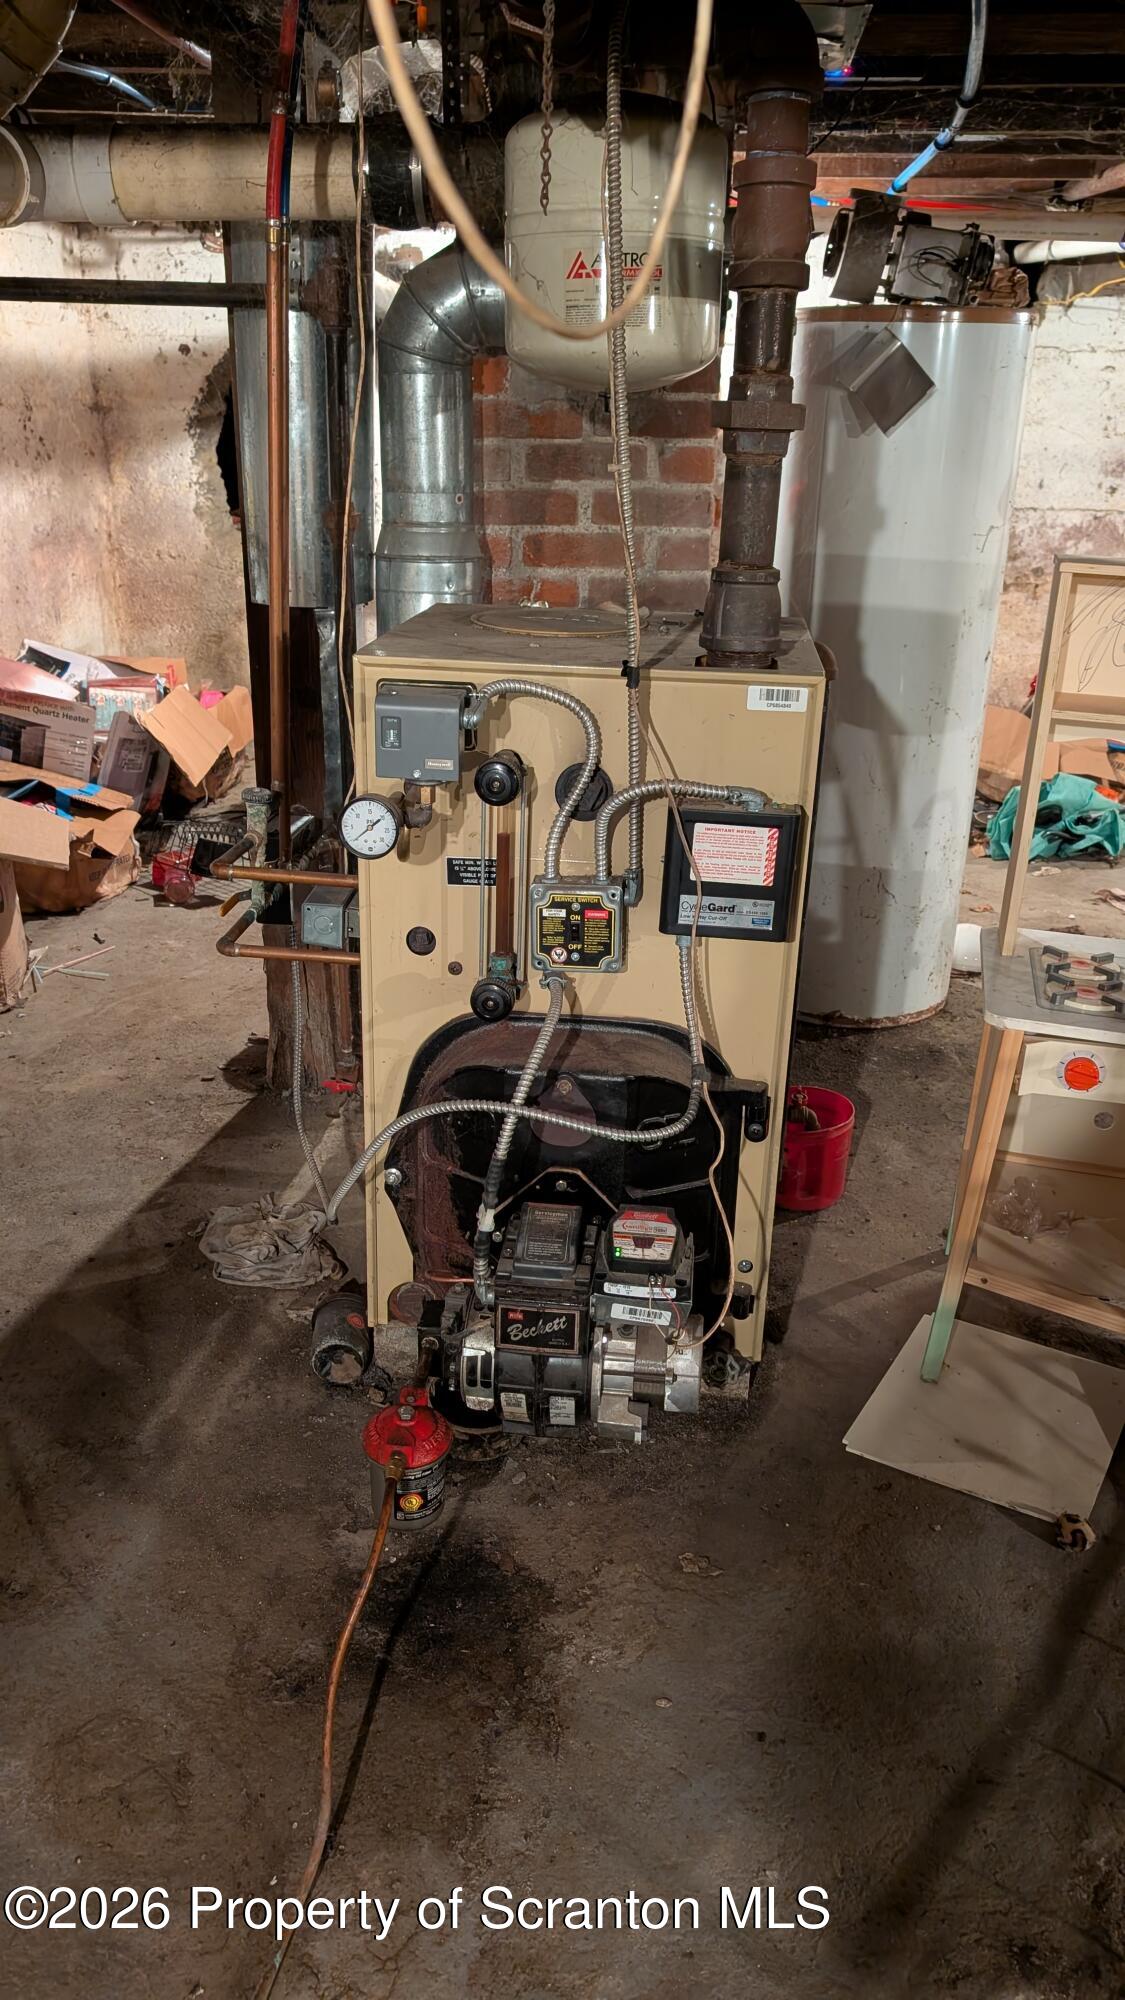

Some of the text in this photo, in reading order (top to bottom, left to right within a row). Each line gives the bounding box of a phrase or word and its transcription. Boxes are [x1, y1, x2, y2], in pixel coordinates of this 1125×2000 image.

[33, 706, 60, 718] Quartz
[62, 712, 90, 724] Heater
[704, 826, 735, 834] IMPORTANT
[577, 896, 599, 904] SWITCH
[568, 943, 582, 951] OFF
[507, 1315, 568, 1341] Beckett
